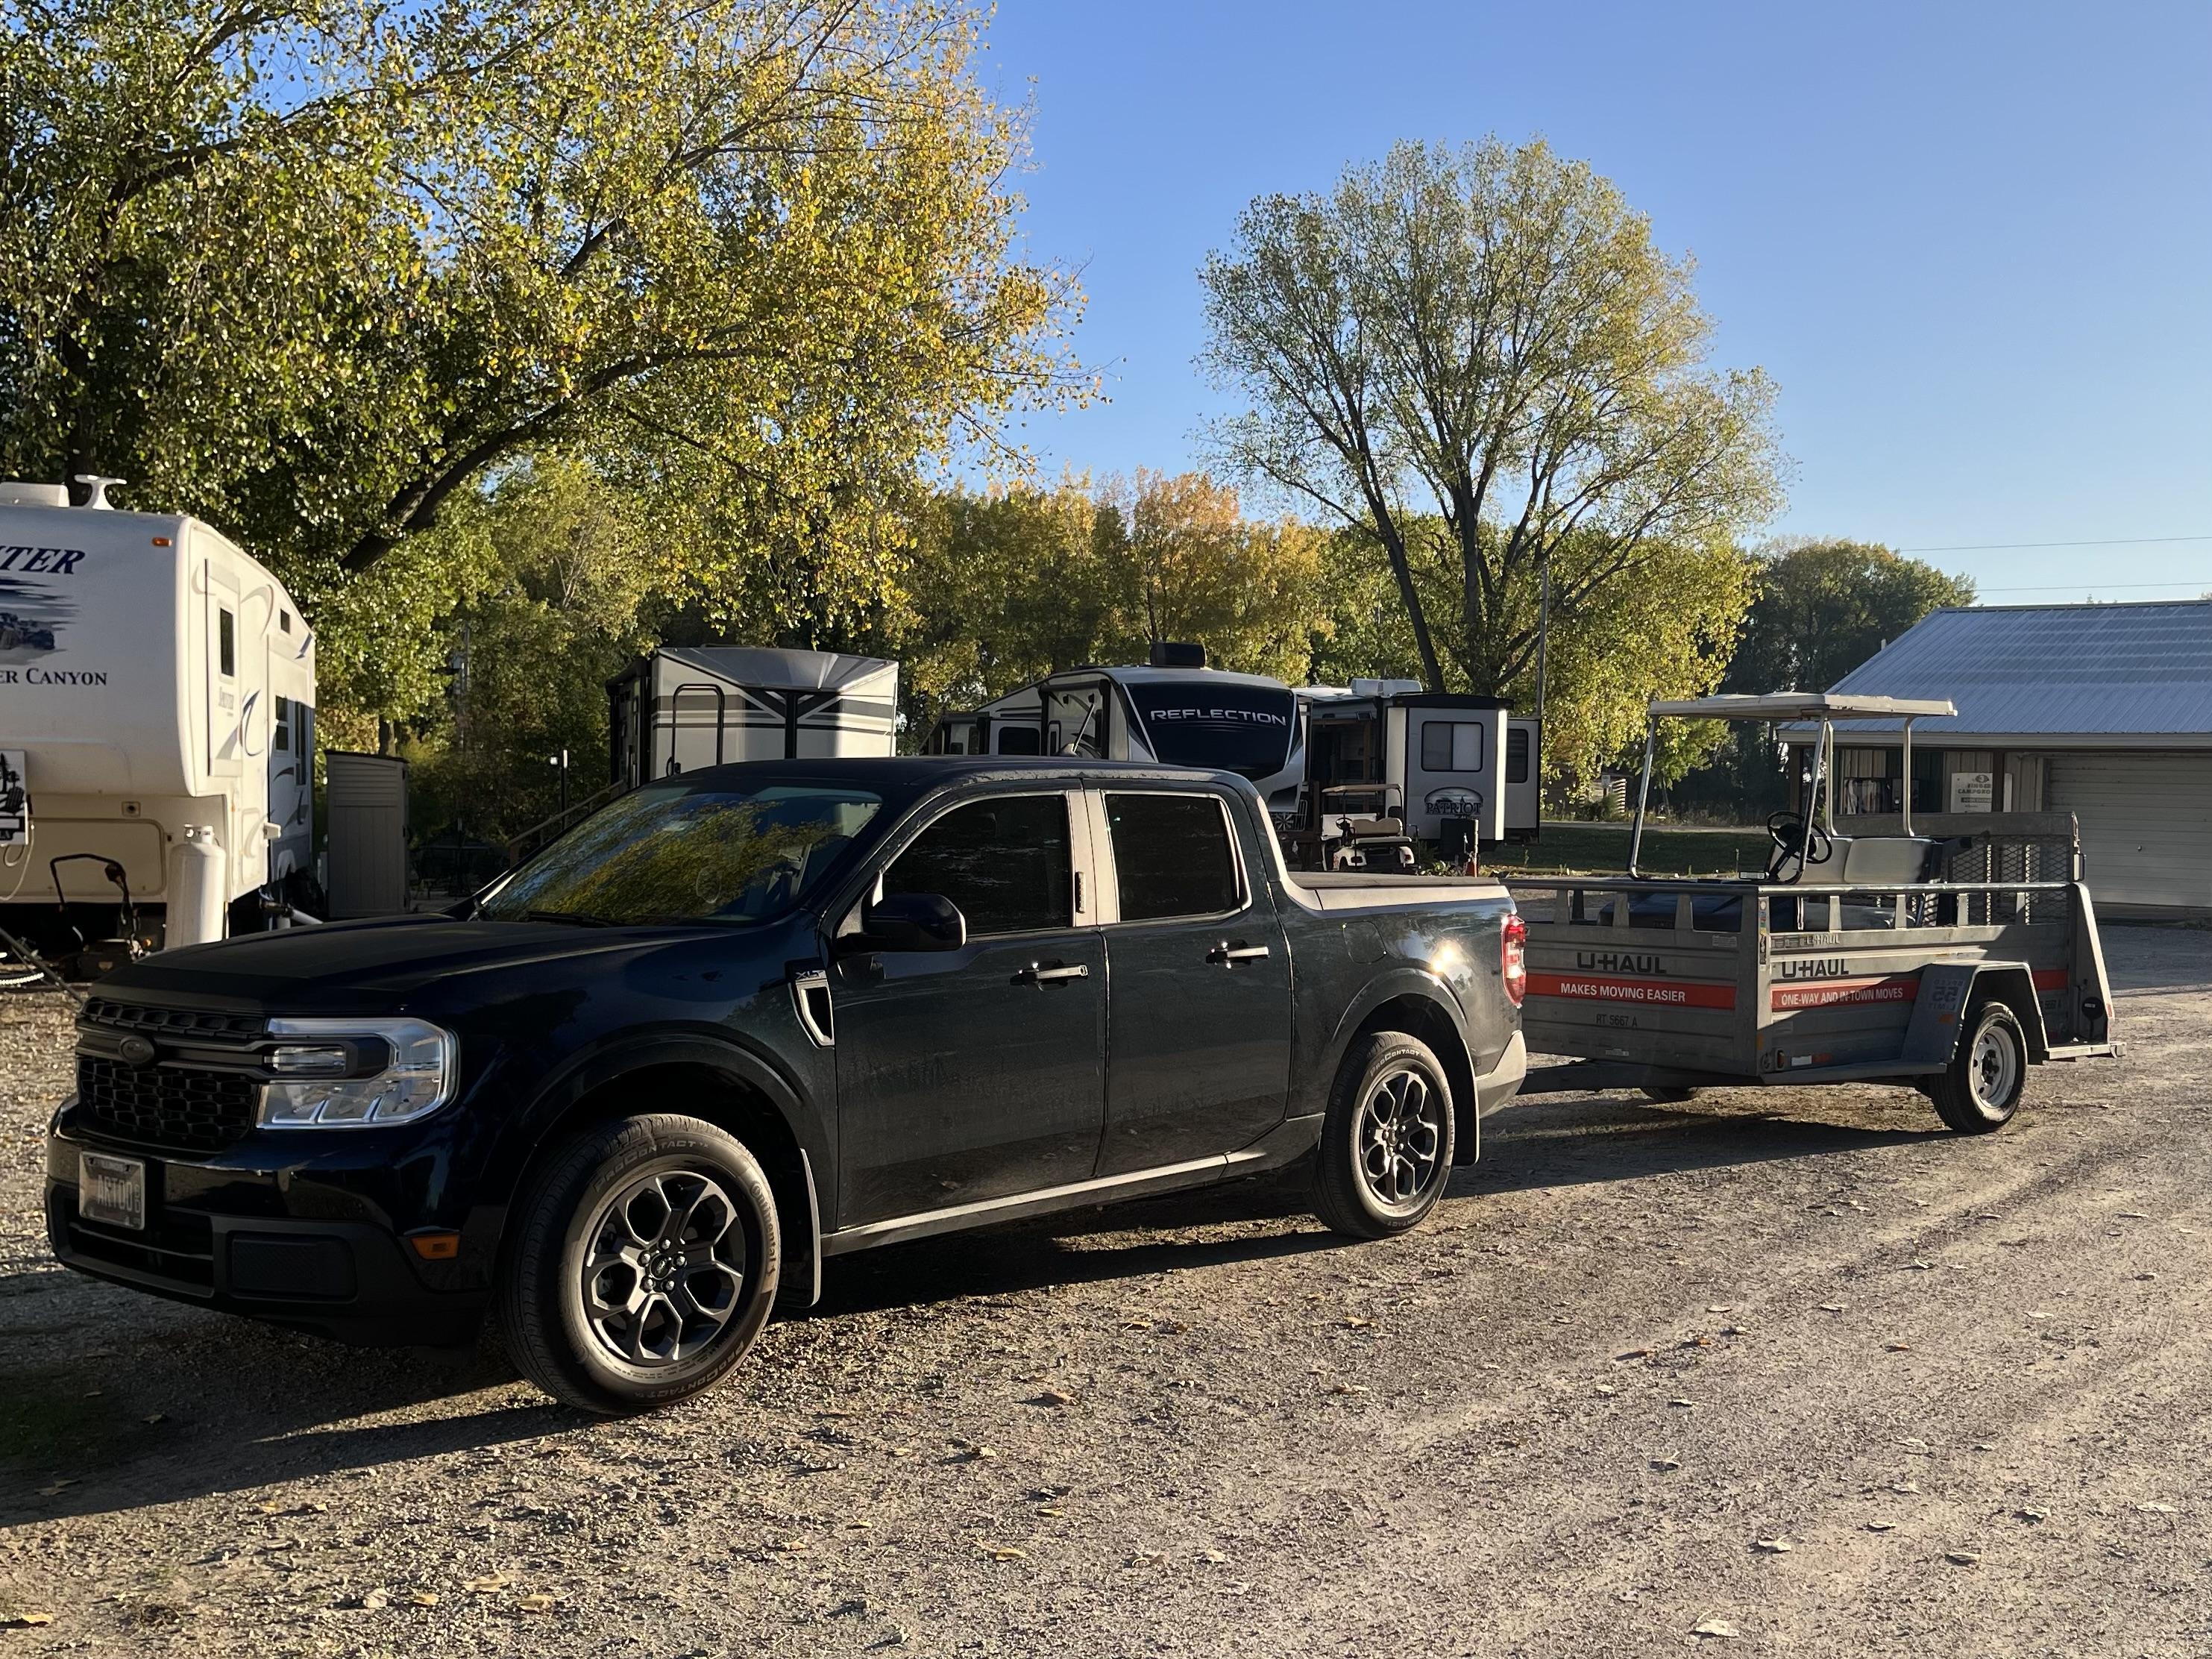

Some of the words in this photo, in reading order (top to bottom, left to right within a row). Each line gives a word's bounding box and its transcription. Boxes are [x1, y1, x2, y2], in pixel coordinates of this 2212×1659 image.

[1151, 709, 1286, 726] REFLECTION
[1425, 802, 1481, 815] PATRIOT
[1577, 953, 1667, 973] U-HAUL
[1782, 959, 1850, 977] U-HAUL
[796, 970, 824, 979] XLT
[1561, 982, 1597, 995] MAKES
[1600, 986, 1644, 999] MOVING
[1647, 989, 1685, 1002] EASIER
[1781, 993, 1820, 1006] ONE-WAY
[1820, 992, 1838, 1003] AND
[1839, 989, 1874, 1001] IN-TOWN
[1875, 988, 1902, 1000] MOVES
[1596, 1014, 1606, 1024] RT
[1632, 1016, 1637, 1026] A
